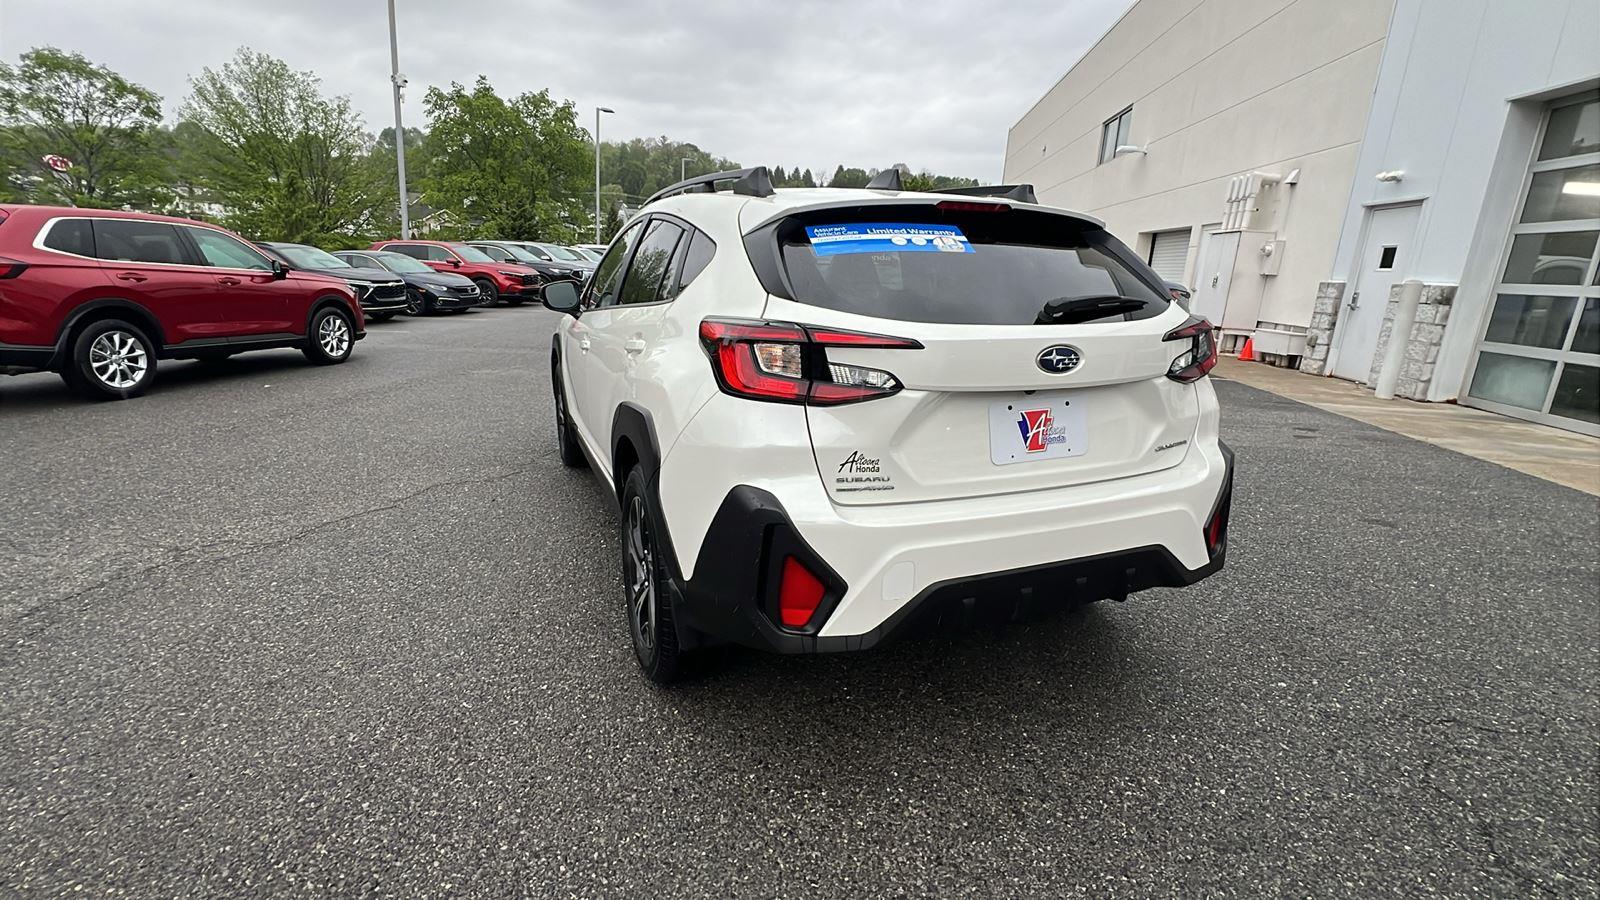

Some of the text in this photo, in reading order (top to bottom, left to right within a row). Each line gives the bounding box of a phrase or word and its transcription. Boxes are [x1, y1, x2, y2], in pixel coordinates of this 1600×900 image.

[907, 228, 956, 236] Warranty
[1042, 435, 1066, 444] Honda
[838, 450, 880, 473] Altoona
[855, 465, 880, 473] Honda
